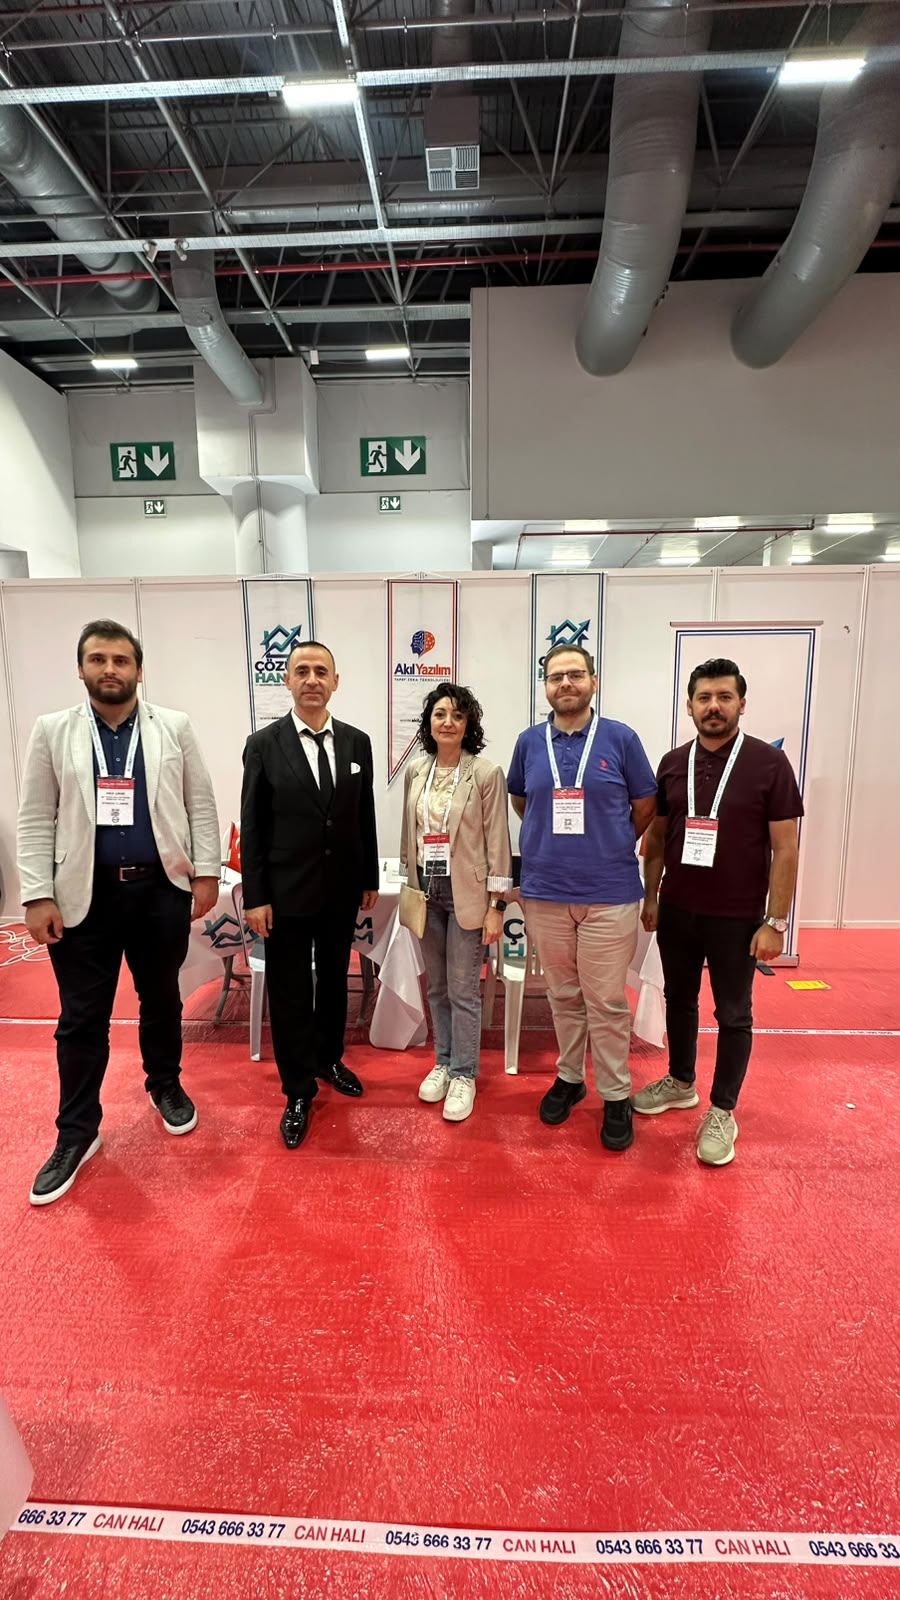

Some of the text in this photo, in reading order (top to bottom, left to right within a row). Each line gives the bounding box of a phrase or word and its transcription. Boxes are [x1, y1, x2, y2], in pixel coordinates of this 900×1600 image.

[254, 658, 288, 674] ÇÖZ
[394, 663, 451, 675] Akıl Yazılım
[18, 1509, 900, 1559] 666 33 77 CAN HALI 0543 666 33 77 CAN HALI 0543 666 33 77 CAN HALI 0543 666 33 77 CAN HALI 0543 666 33
